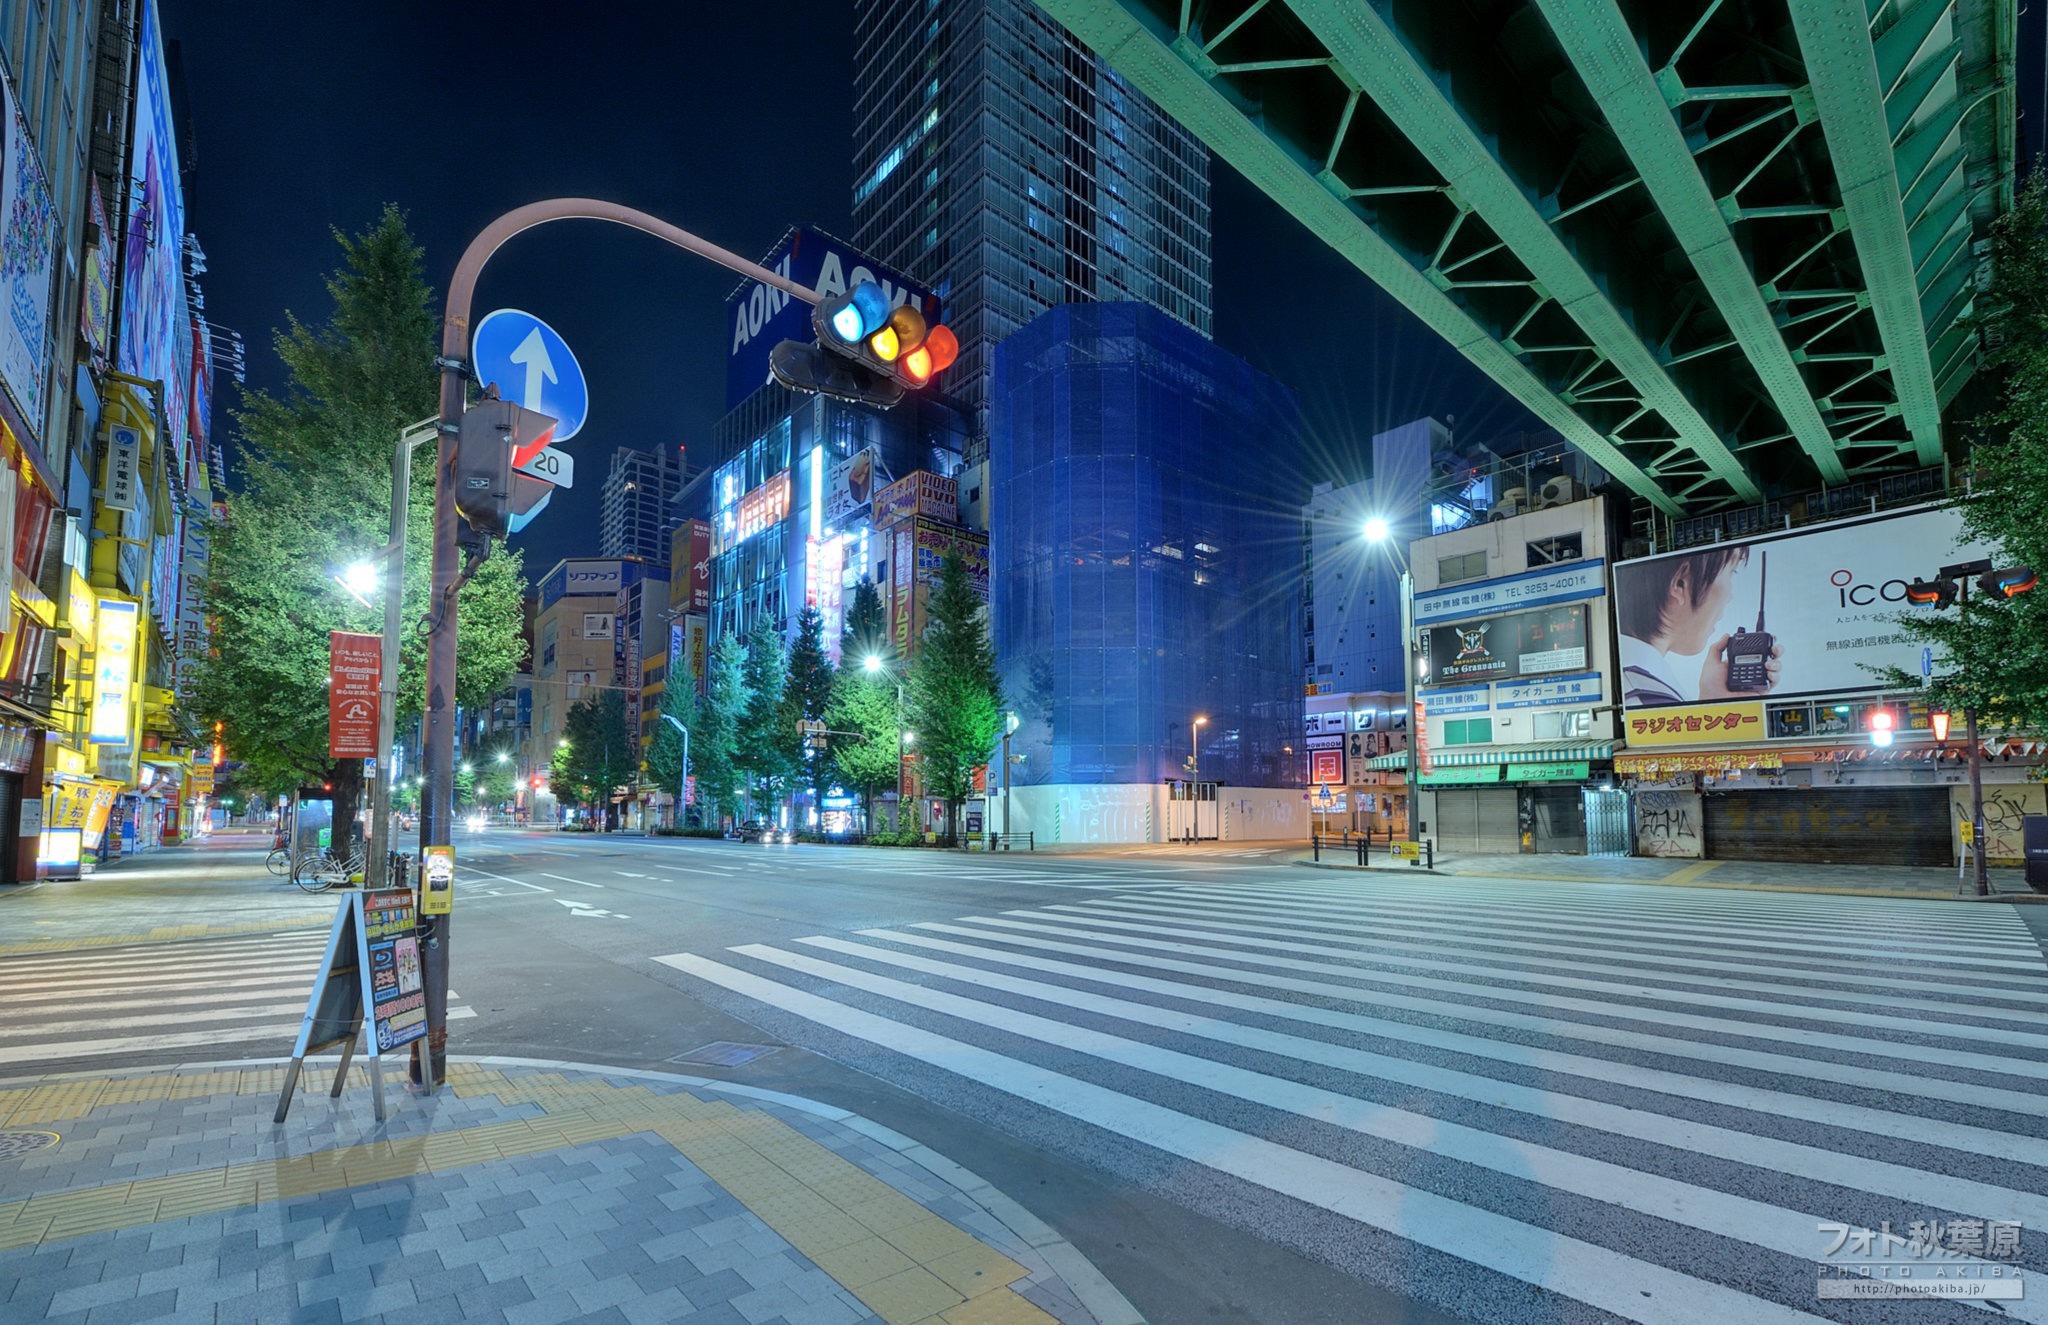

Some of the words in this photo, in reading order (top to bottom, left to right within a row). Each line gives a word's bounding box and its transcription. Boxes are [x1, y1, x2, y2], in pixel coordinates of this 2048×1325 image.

[732, 253, 791, 356] AOKI
[534, 452, 560, 476] 20
[921, 474, 955, 492] VIDEO
[922, 488, 955, 505] DVD
[921, 499, 956, 521] MAGAZINE
[1423, 591, 1497, 613] 田中無線電機(株)
[1505, 587, 1522, 599] TEL
[896, 584, 910, 661] ラムタラ
[1442, 666, 1460, 676] The
[1461, 660, 1506, 674] Granvania
[1512, 683, 1582, 698] タイガー無線
[1632, 713, 1759, 734] ラジオセンター
[1306, 741, 1342, 749] HOWROOM
[988, 772, 996, 782] P
[1522, 768, 1575, 778] タイガー無線
